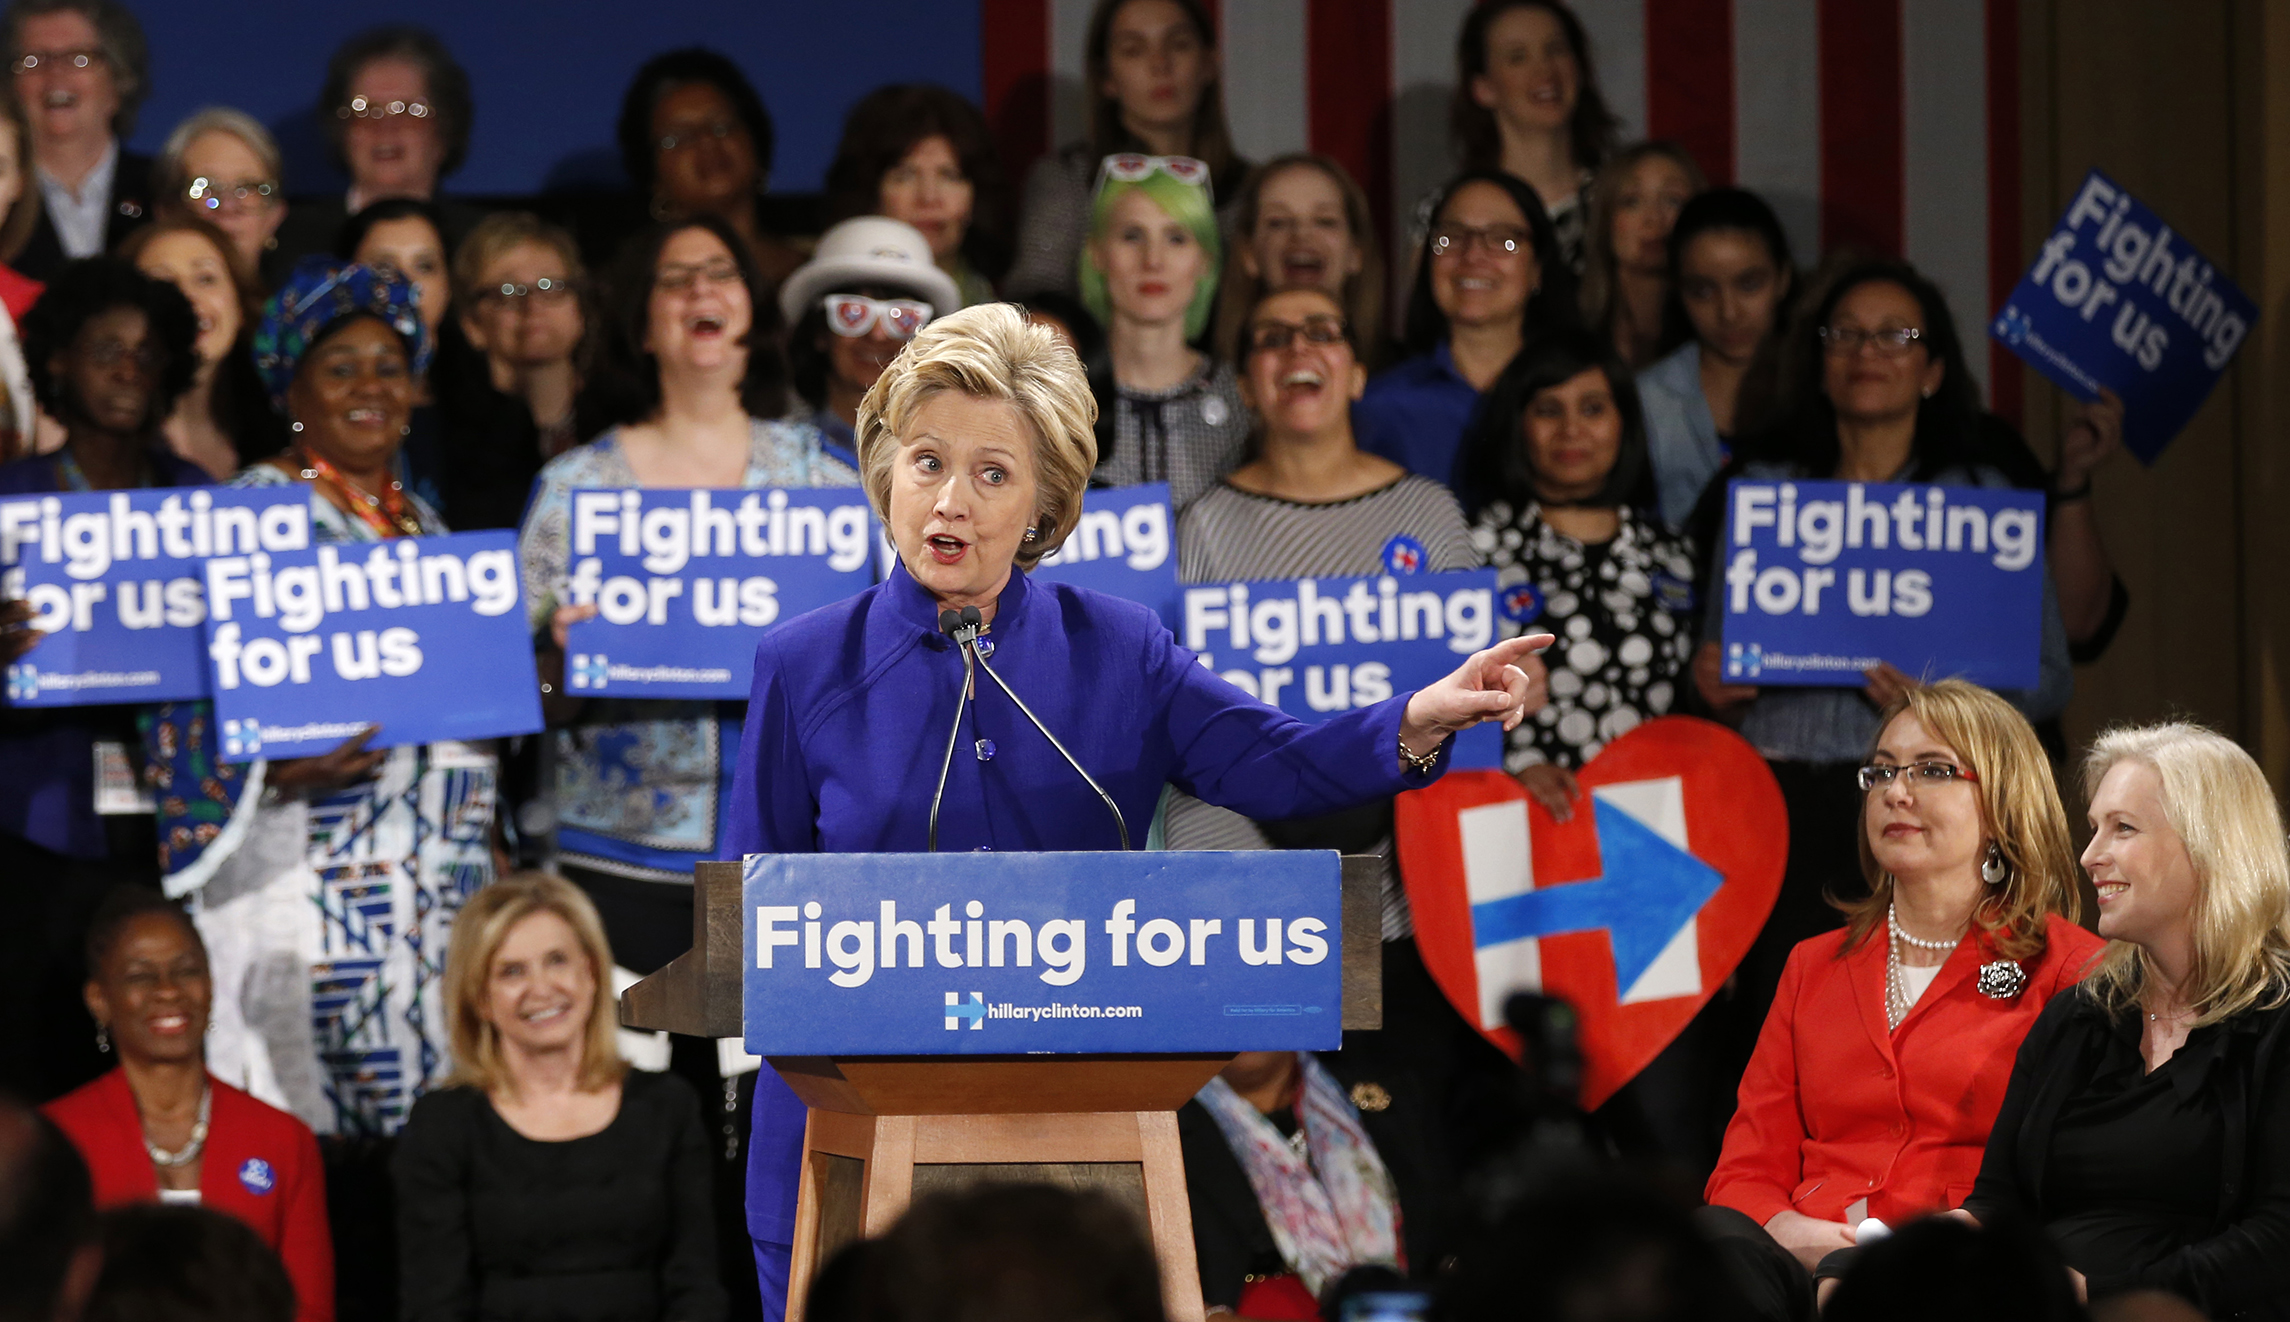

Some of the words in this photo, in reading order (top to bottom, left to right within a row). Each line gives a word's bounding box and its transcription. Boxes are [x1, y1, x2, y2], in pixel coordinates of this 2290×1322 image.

[2031, 230, 2118, 322] for
[2111, 300, 2169, 372] us
[2067, 174, 2246, 371] Fighting
[573, 488, 869, 573] Fighting
[1733, 482, 2038, 572] Fighting
[116, 576, 206, 630] us
[206, 540, 517, 632] Fighting
[572, 560, 682, 626] for
[692, 575, 780, 628] us
[1184, 578, 1494, 666] Fighting
[1726, 548, 1836, 616] for
[1847, 567, 1934, 617] us
[209, 621, 322, 690] for
[330, 626, 424, 681] us
[1304, 660, 1394, 712] us
[756, 899, 1087, 988] Fighting
[1105, 898, 1222, 968] for
[1237, 915, 1330, 967] us
[988, 1002, 1144, 1022] hillaryclinton.com
